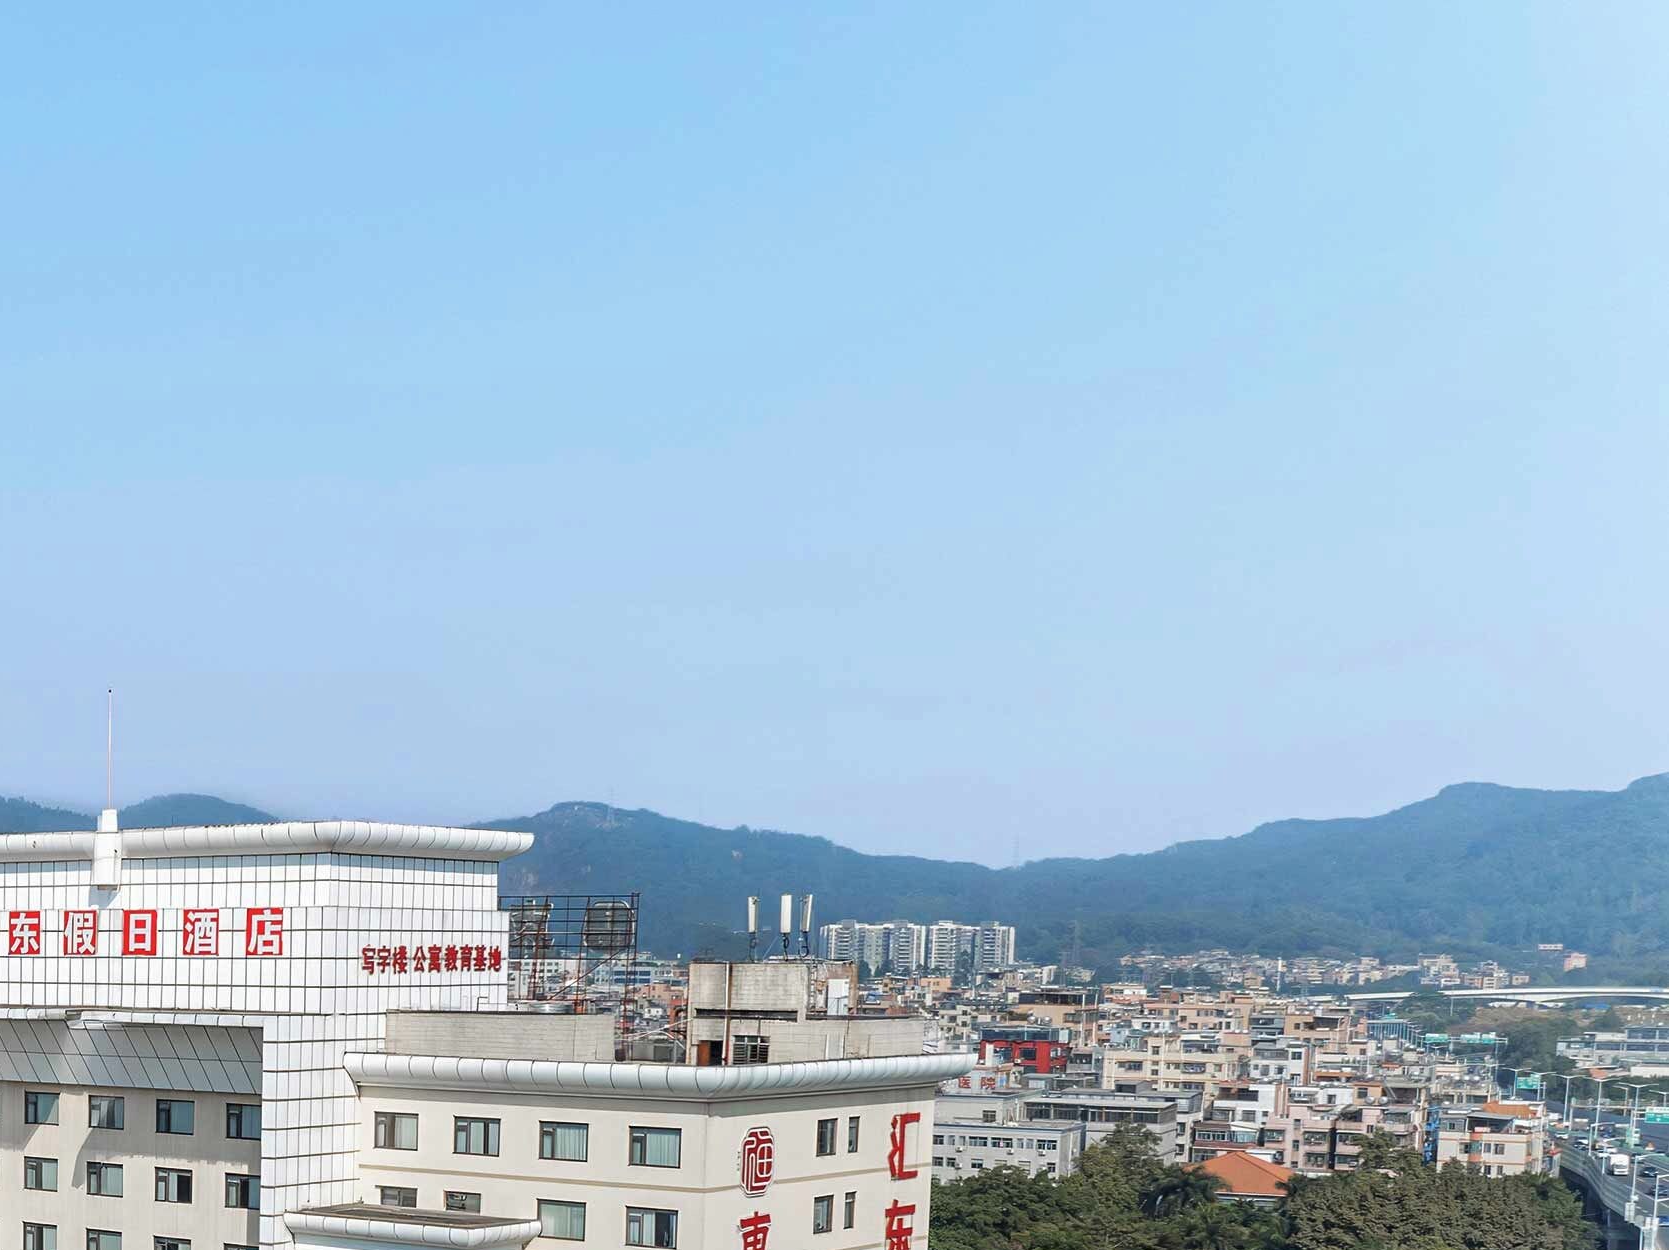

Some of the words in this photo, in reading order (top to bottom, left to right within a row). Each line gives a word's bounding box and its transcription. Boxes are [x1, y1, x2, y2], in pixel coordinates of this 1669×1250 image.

[361, 943, 408, 976] 写字楼
[412, 943, 502, 974] 公寓教育基地
